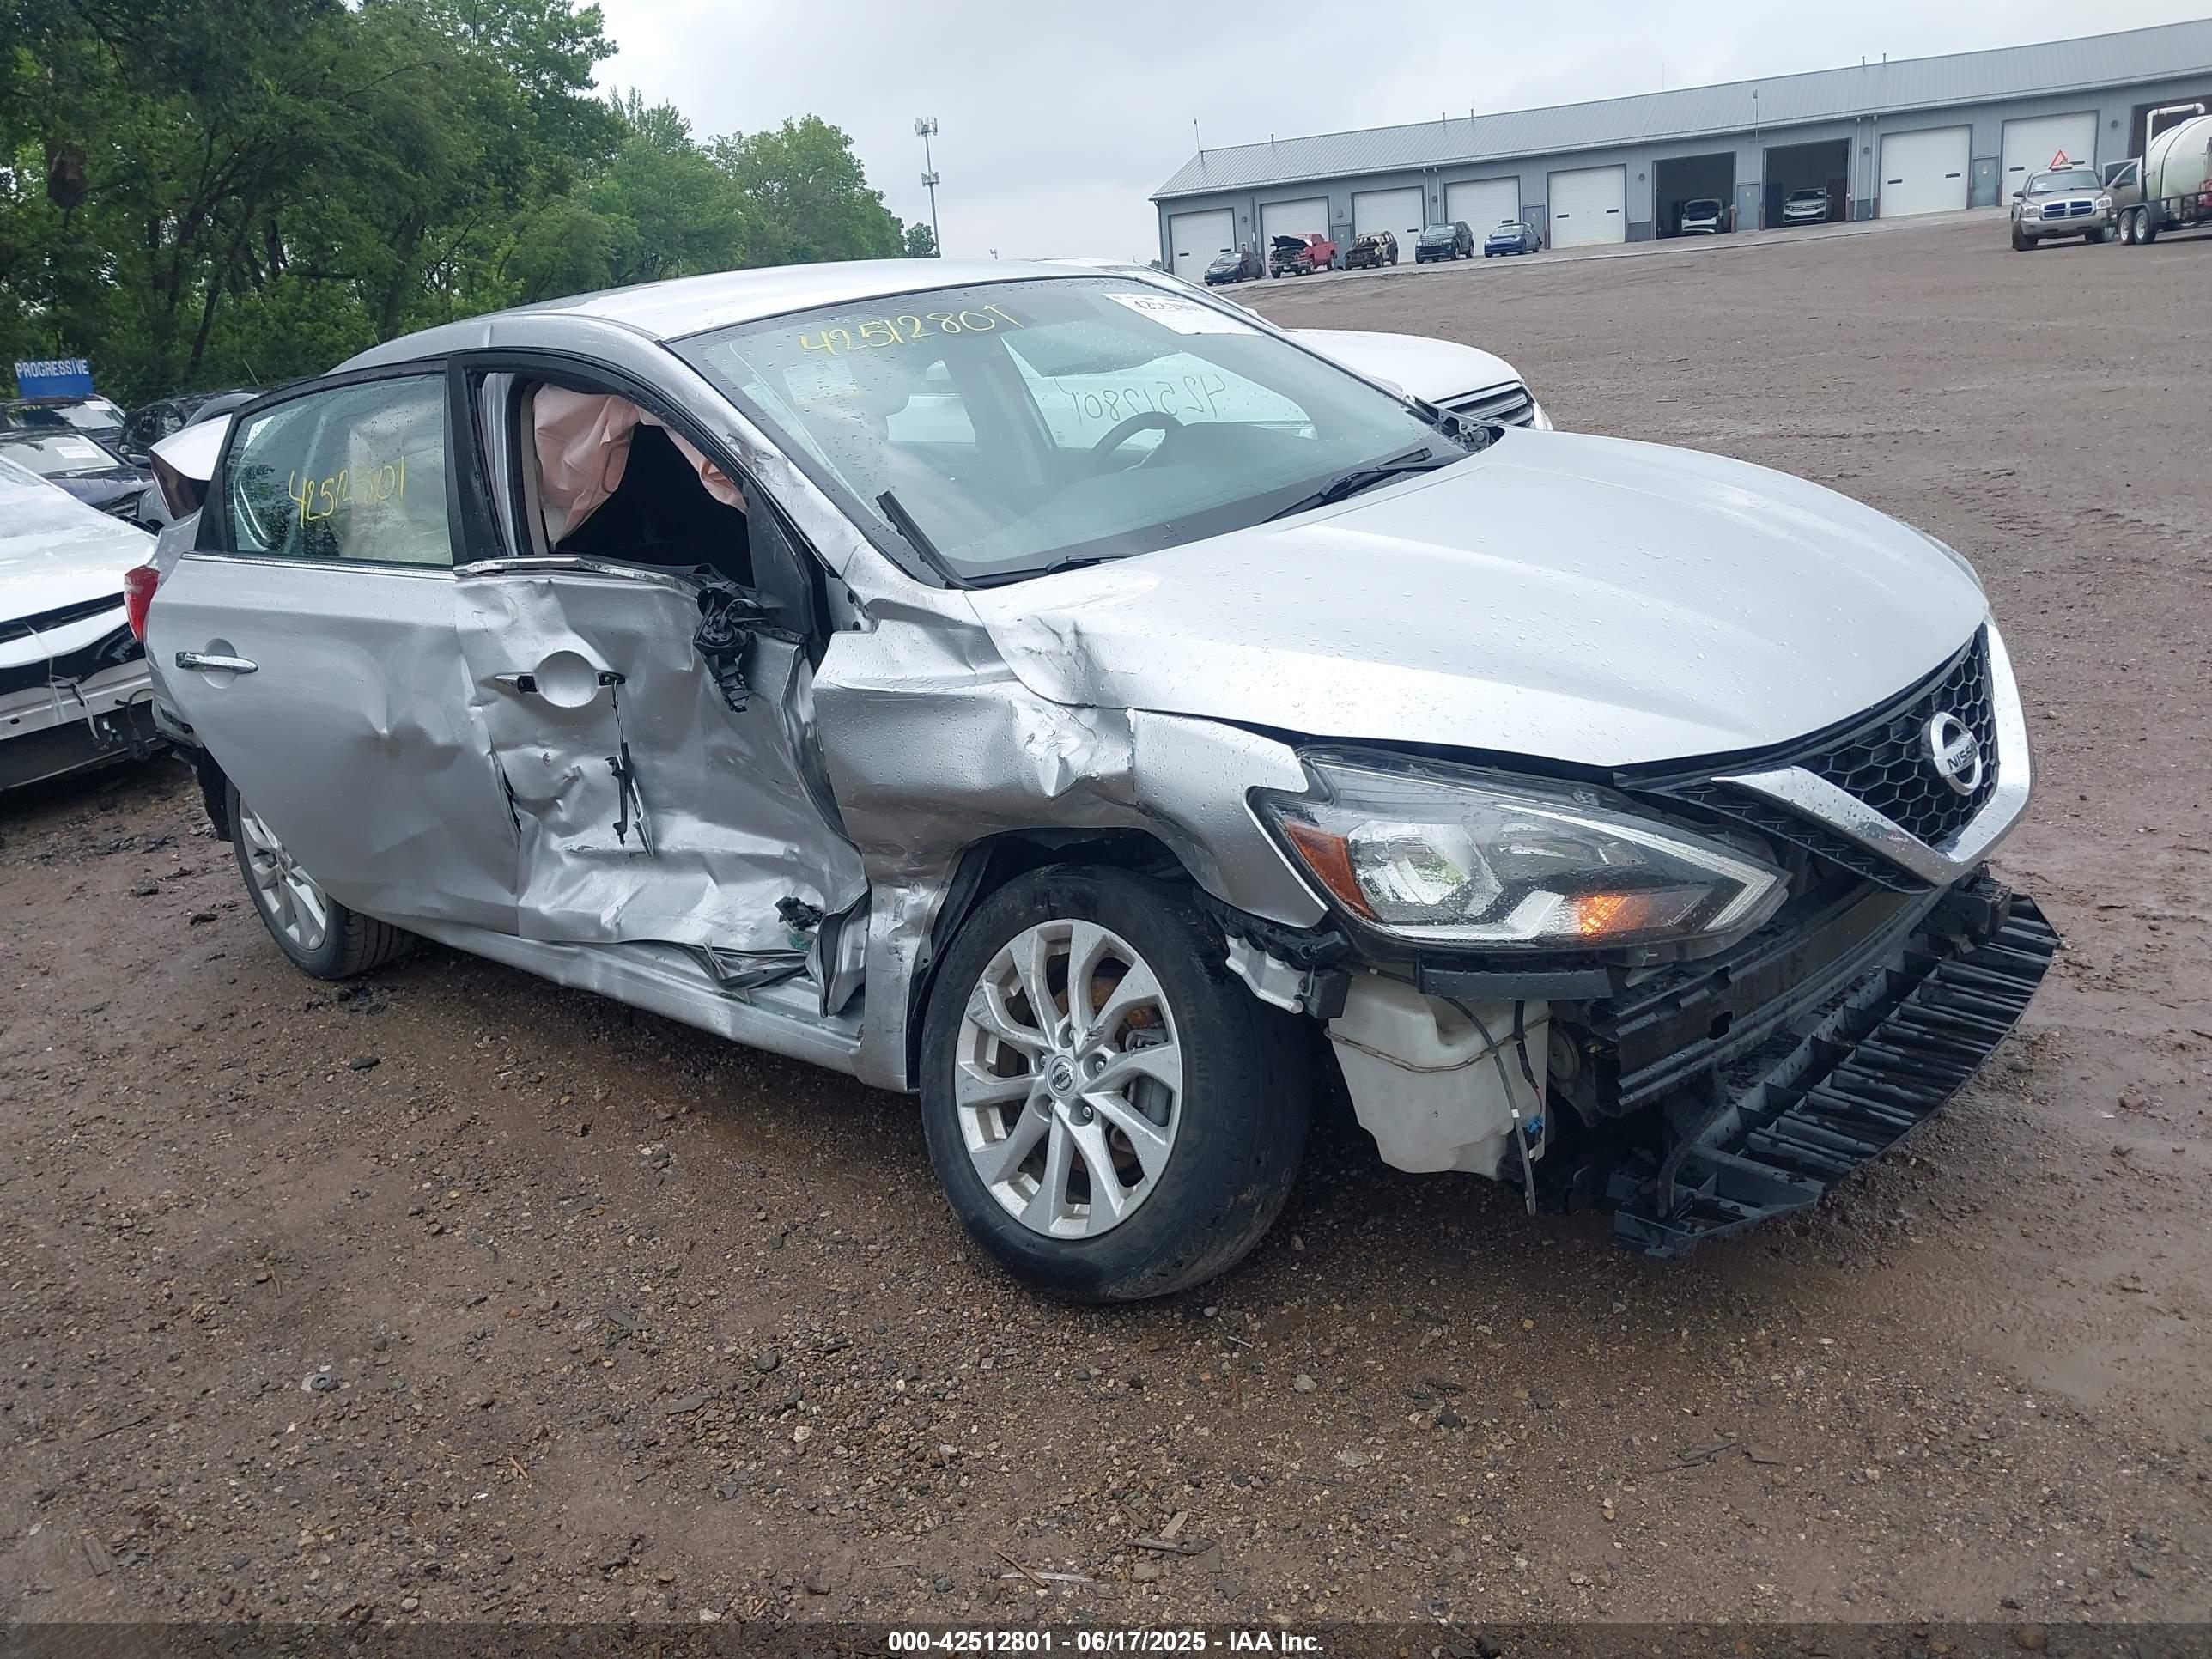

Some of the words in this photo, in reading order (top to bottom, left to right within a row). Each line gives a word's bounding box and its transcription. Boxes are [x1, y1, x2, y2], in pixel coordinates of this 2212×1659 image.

[799, 303, 1024, 356] 42512801
[15, 360, 89, 378] PROGRESSIVE
[1946, 742, 1976, 770] NISS
